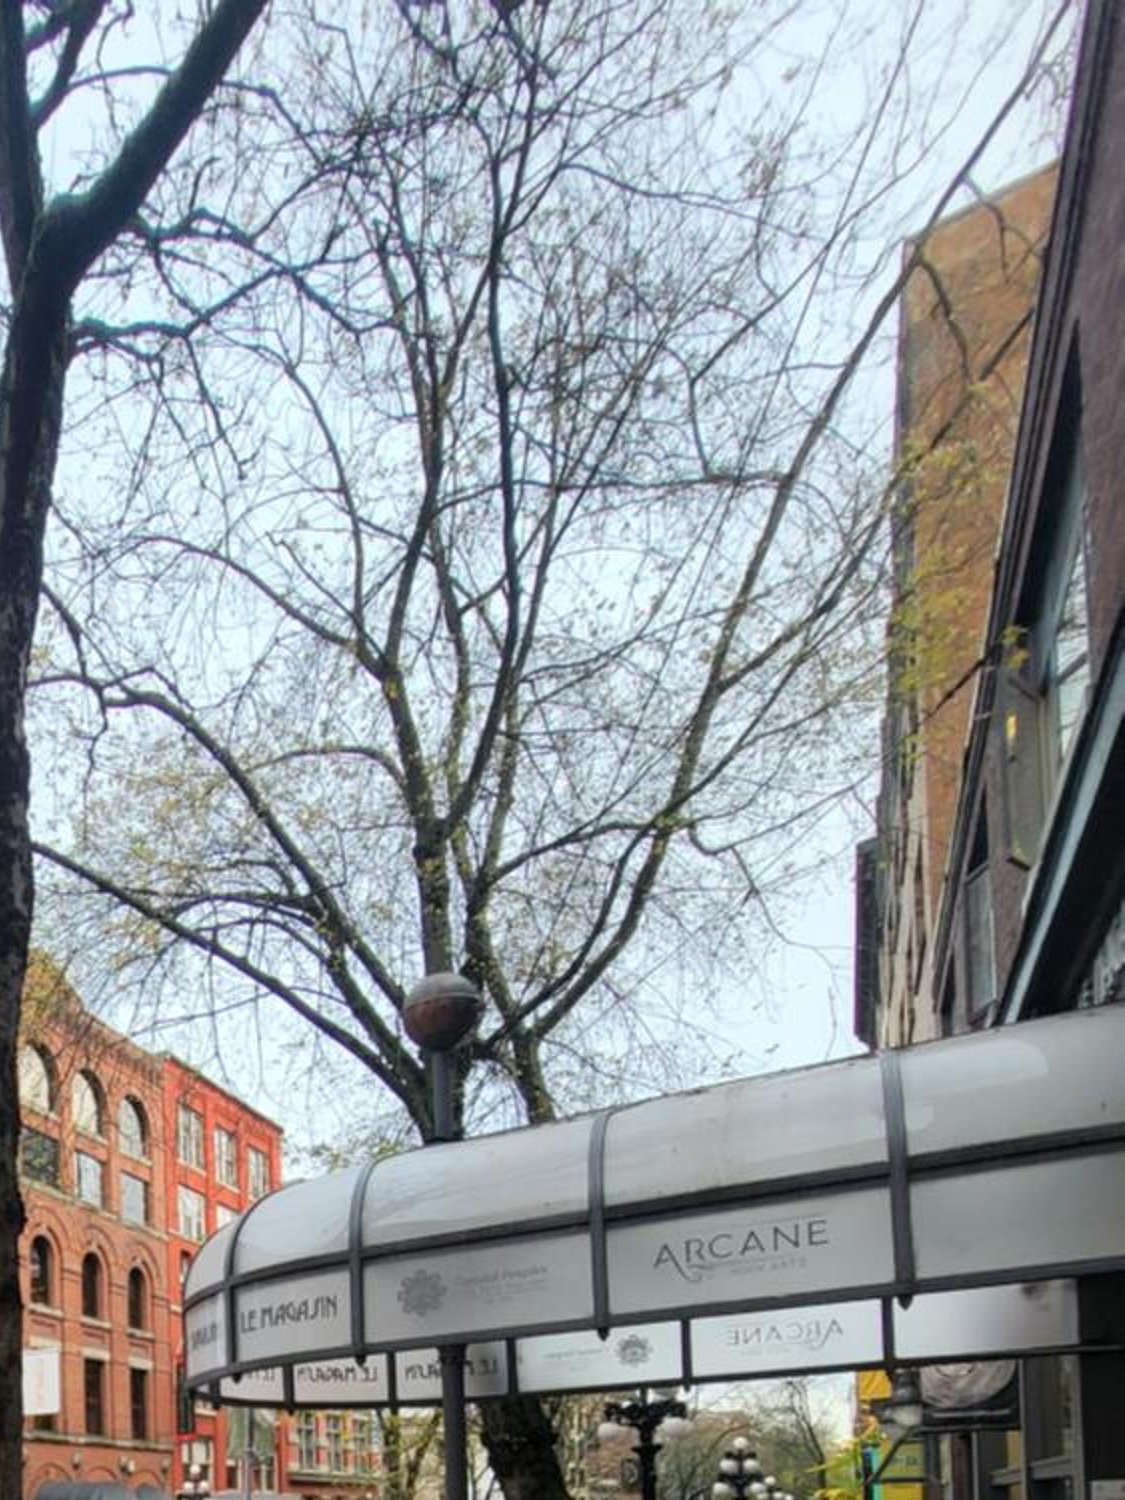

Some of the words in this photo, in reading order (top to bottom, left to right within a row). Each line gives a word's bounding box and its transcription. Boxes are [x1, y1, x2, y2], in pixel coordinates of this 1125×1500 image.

[653, 1219, 829, 1283] ARCANE
[241, 1311, 260, 1334] LE
[260, 1295, 339, 1329] MAGASIN
